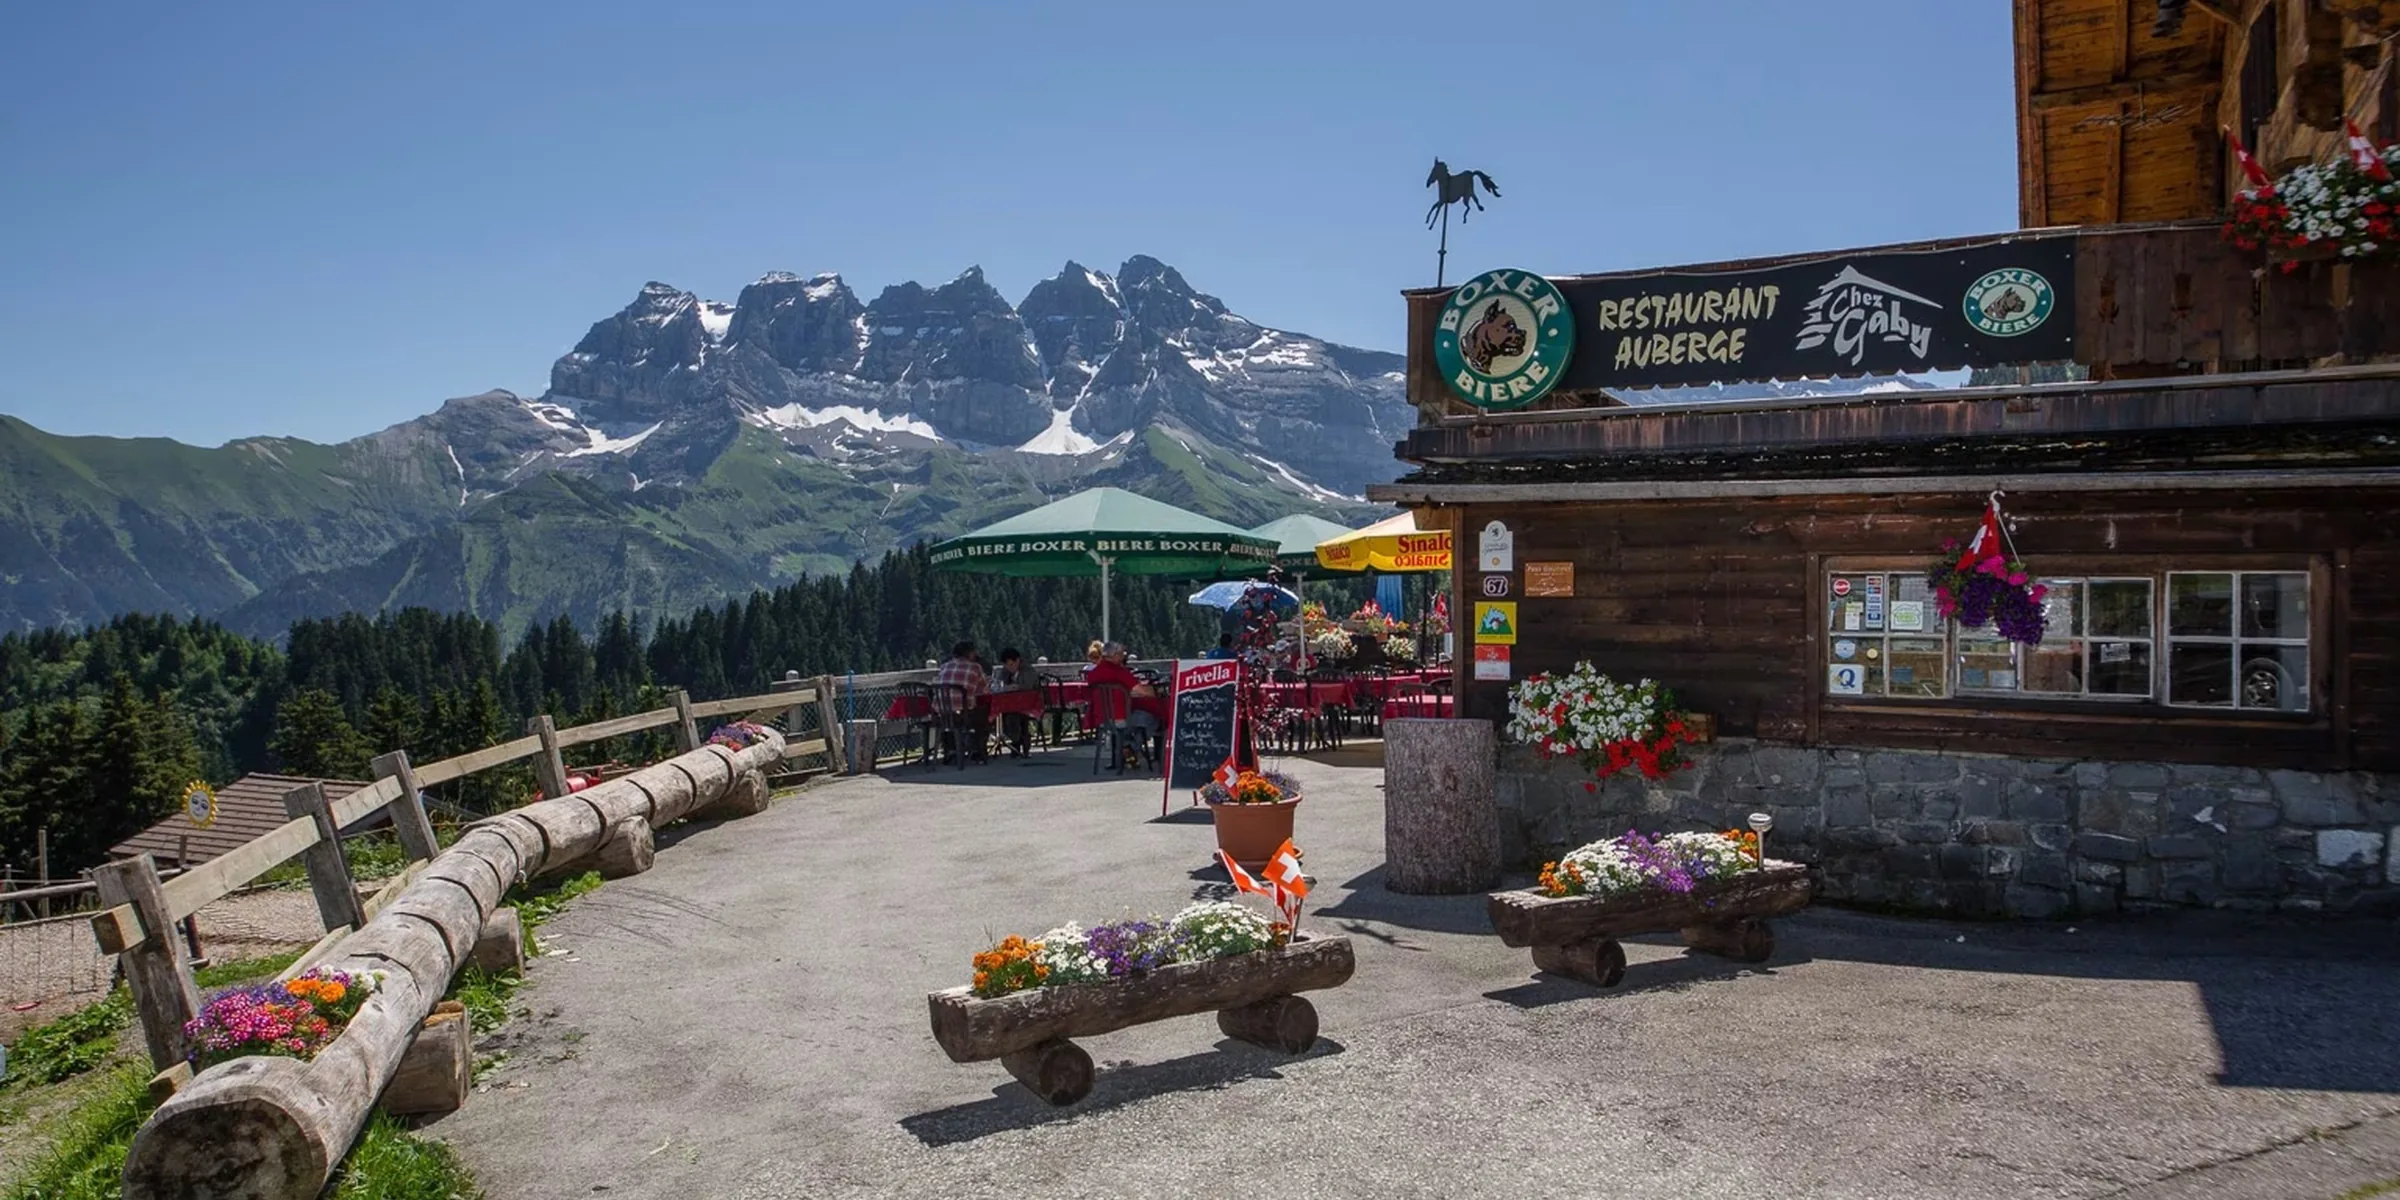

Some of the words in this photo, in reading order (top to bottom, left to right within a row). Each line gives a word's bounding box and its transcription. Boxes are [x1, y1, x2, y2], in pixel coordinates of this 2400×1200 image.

[1969, 270, 2047, 300] BOXER
[1440, 271, 1560, 333] BOXER
[1599, 285, 1781, 331] RESTAURANT
[1828, 285, 1884, 322] Chez
[1833, 300, 1933, 366] Gaby
[1978, 313, 2040, 334] BIERE
[1614, 328, 1748, 371] AUBERGE
[1455, 360, 1550, 402] BIERE
[967, 543, 1016, 556] BIERE
[1020, 540, 1087, 553] BOXER
[1096, 540, 1155, 551] BIERE
[1159, 540, 1223, 551] BOXER
[1487, 580, 1504, 593] 67
[1184, 665, 1231, 688] rivella
